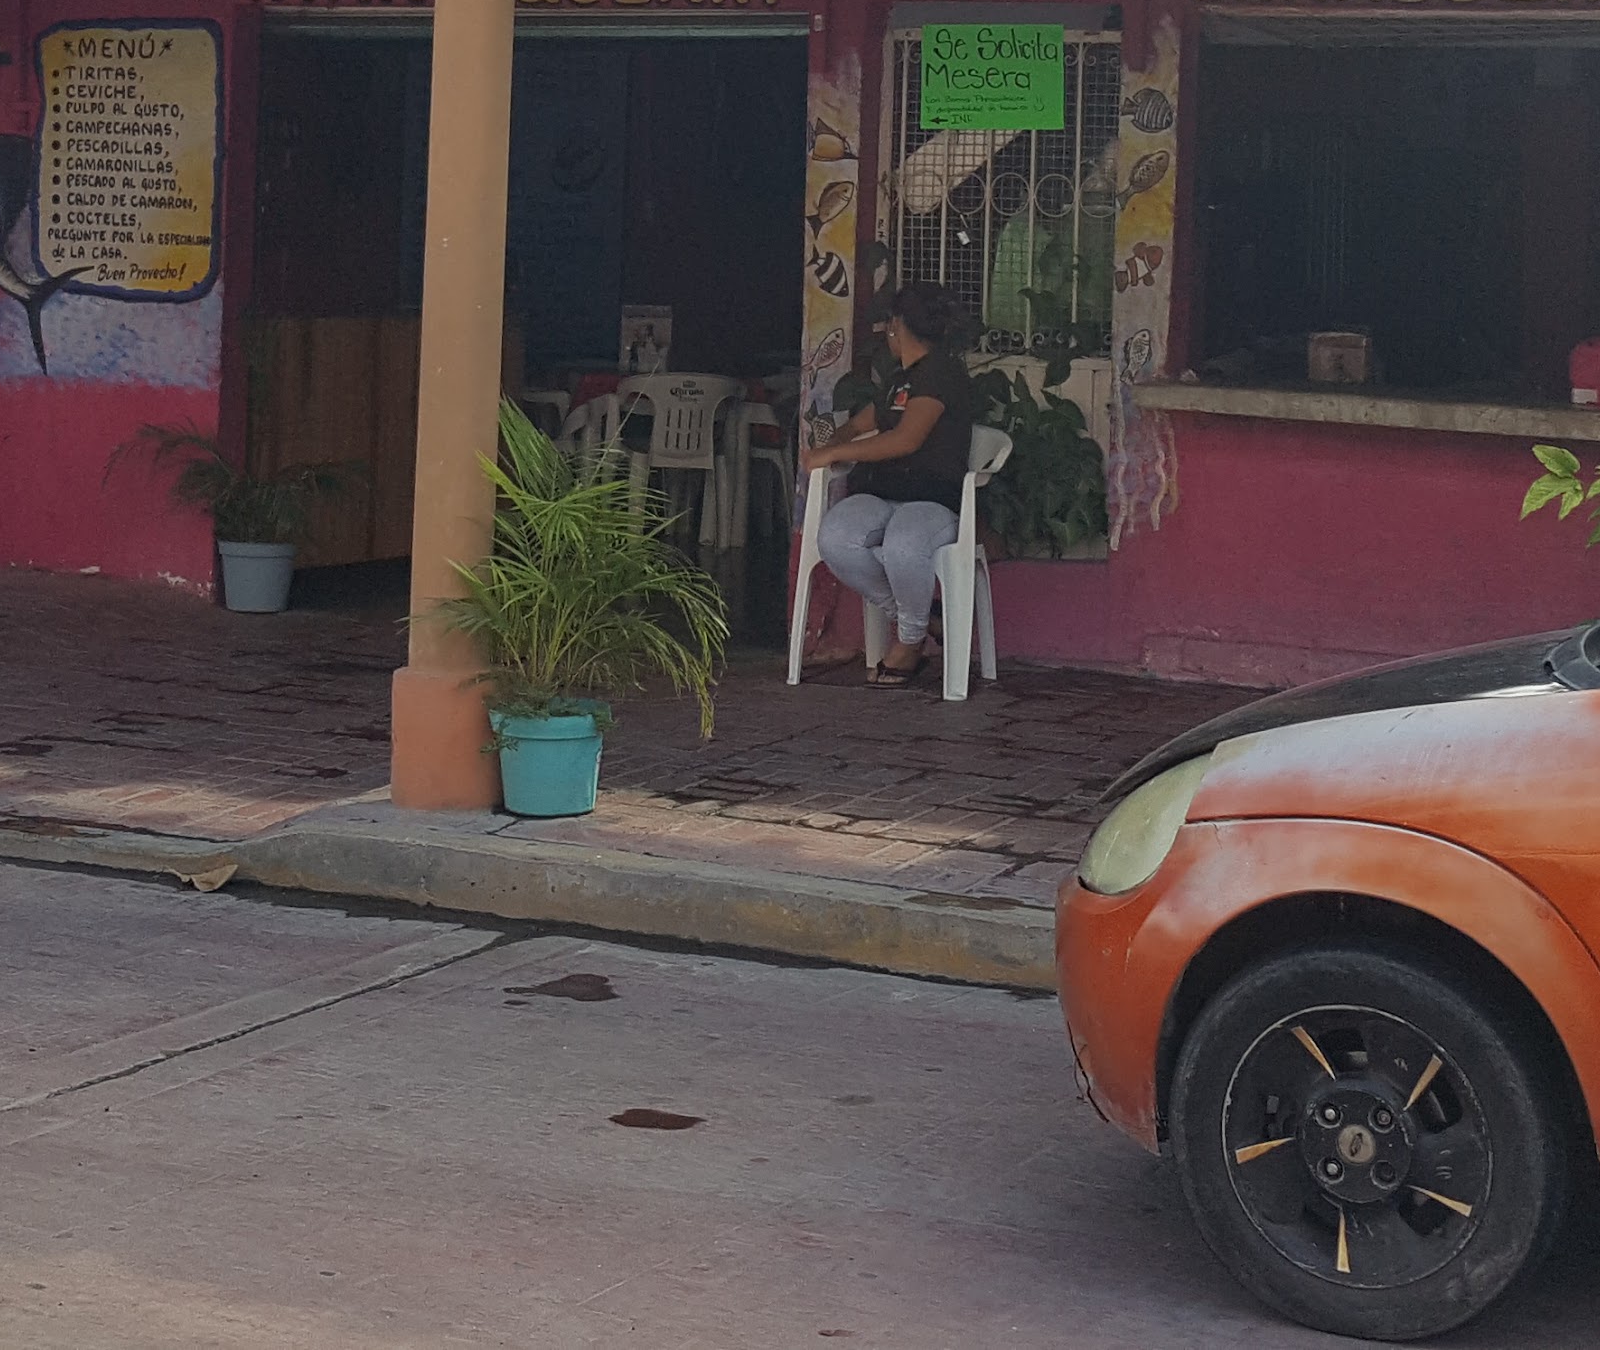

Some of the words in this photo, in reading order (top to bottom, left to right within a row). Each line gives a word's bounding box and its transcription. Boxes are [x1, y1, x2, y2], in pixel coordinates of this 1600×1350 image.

[933, 28, 968, 61] Se
[976, 27, 1059, 62] Solicita
[64, 65, 144, 82] TIRITAS,
[924, 62, 1031, 91] Mesera
[65, 84, 145, 101] CEVICHE,
[65, 101, 105, 115] PULPO
[112, 102, 128, 115] AL
[134, 103, 185, 120] GUSTO,
[66, 120, 180, 139] CAMPECHANAS,
[67, 138, 170, 158] PESCADILLAS,
[66, 157, 179, 176] CAMARONILLAS,
[66, 174, 116, 188] PESCADO
[122, 176, 136, 189] AL
[141, 178, 182, 194] GUSTO,
[67, 192, 105, 206] CALDO
[111, 194, 127, 207] DE
[130, 195, 198, 212] CAMARON,
[67, 212, 142, 230] COCTELES,
[47, 228, 106, 243] PREGUNTE
[112, 231, 134, 244] POR
[140, 233, 154, 244] LA
[70, 246, 86, 259] LA
[91, 246, 128, 260] CASA.
[97, 263, 126, 282] Buen
